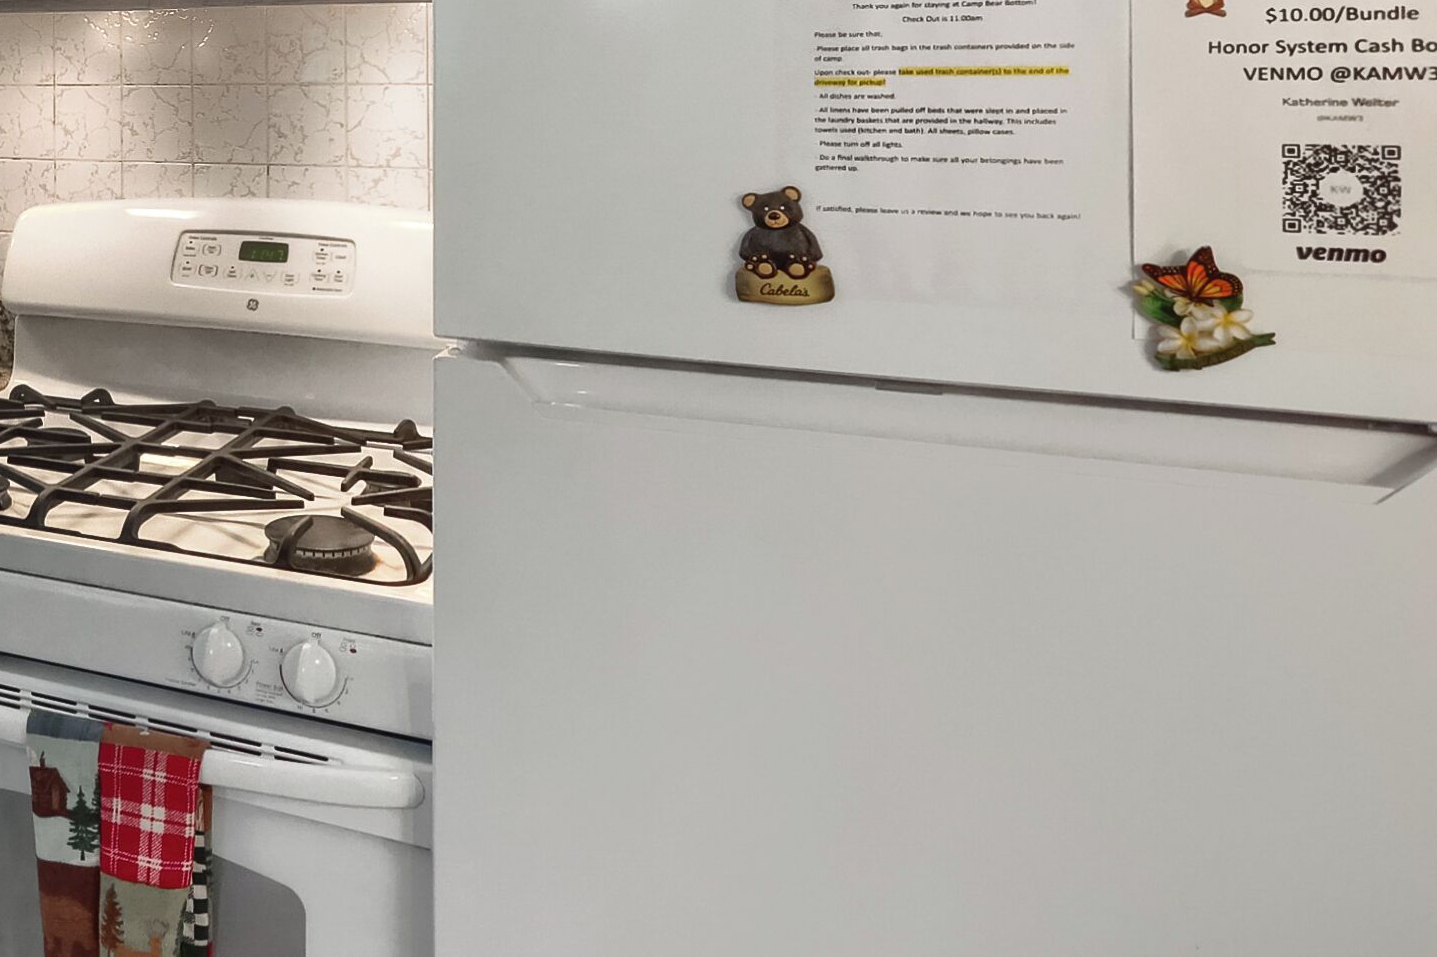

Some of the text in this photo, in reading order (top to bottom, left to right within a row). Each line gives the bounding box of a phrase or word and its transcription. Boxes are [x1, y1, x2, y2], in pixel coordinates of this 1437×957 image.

[1265, 6, 1419, 24] $10.00/Bundle
[1208, 40, 1269, 54] Honor
[1275, 40, 1348, 57] System
[1354, 38, 1404, 54] Cash
[1243, 67, 1323, 81] VENMO
[1281, 98, 1349, 108] Katherine
[1296, 246, 1387, 264] venmo
